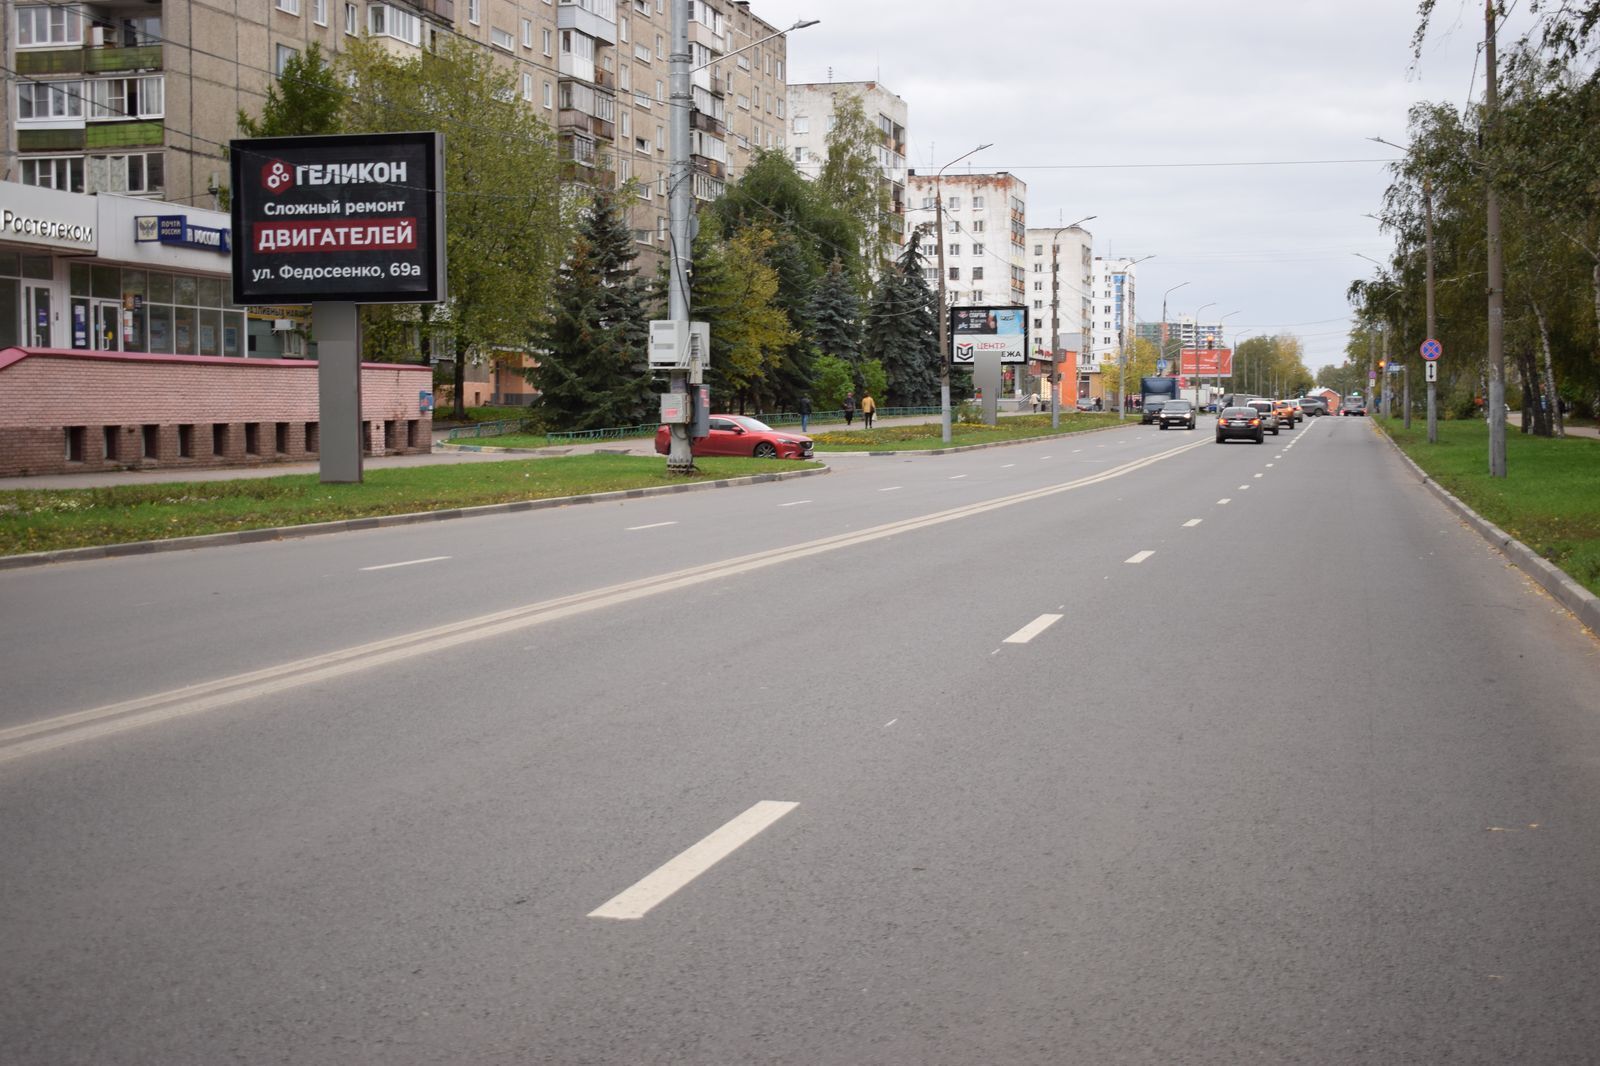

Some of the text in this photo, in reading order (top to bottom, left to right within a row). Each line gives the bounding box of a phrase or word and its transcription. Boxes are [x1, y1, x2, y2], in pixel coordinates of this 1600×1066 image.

[296, 162, 407, 185] ГЕЛИКОН
[264, 200, 405, 216] Сложный ремонт
[1, 209, 93, 242] Ростелеком
[161, 220, 181, 228] ПОЧТА
[194, 229, 220, 245] РОССИИ
[259, 221, 412, 250] ДВИГАТЕЛЕЙ
[252, 262, 421, 282] ул. Федосеенко, 69а
